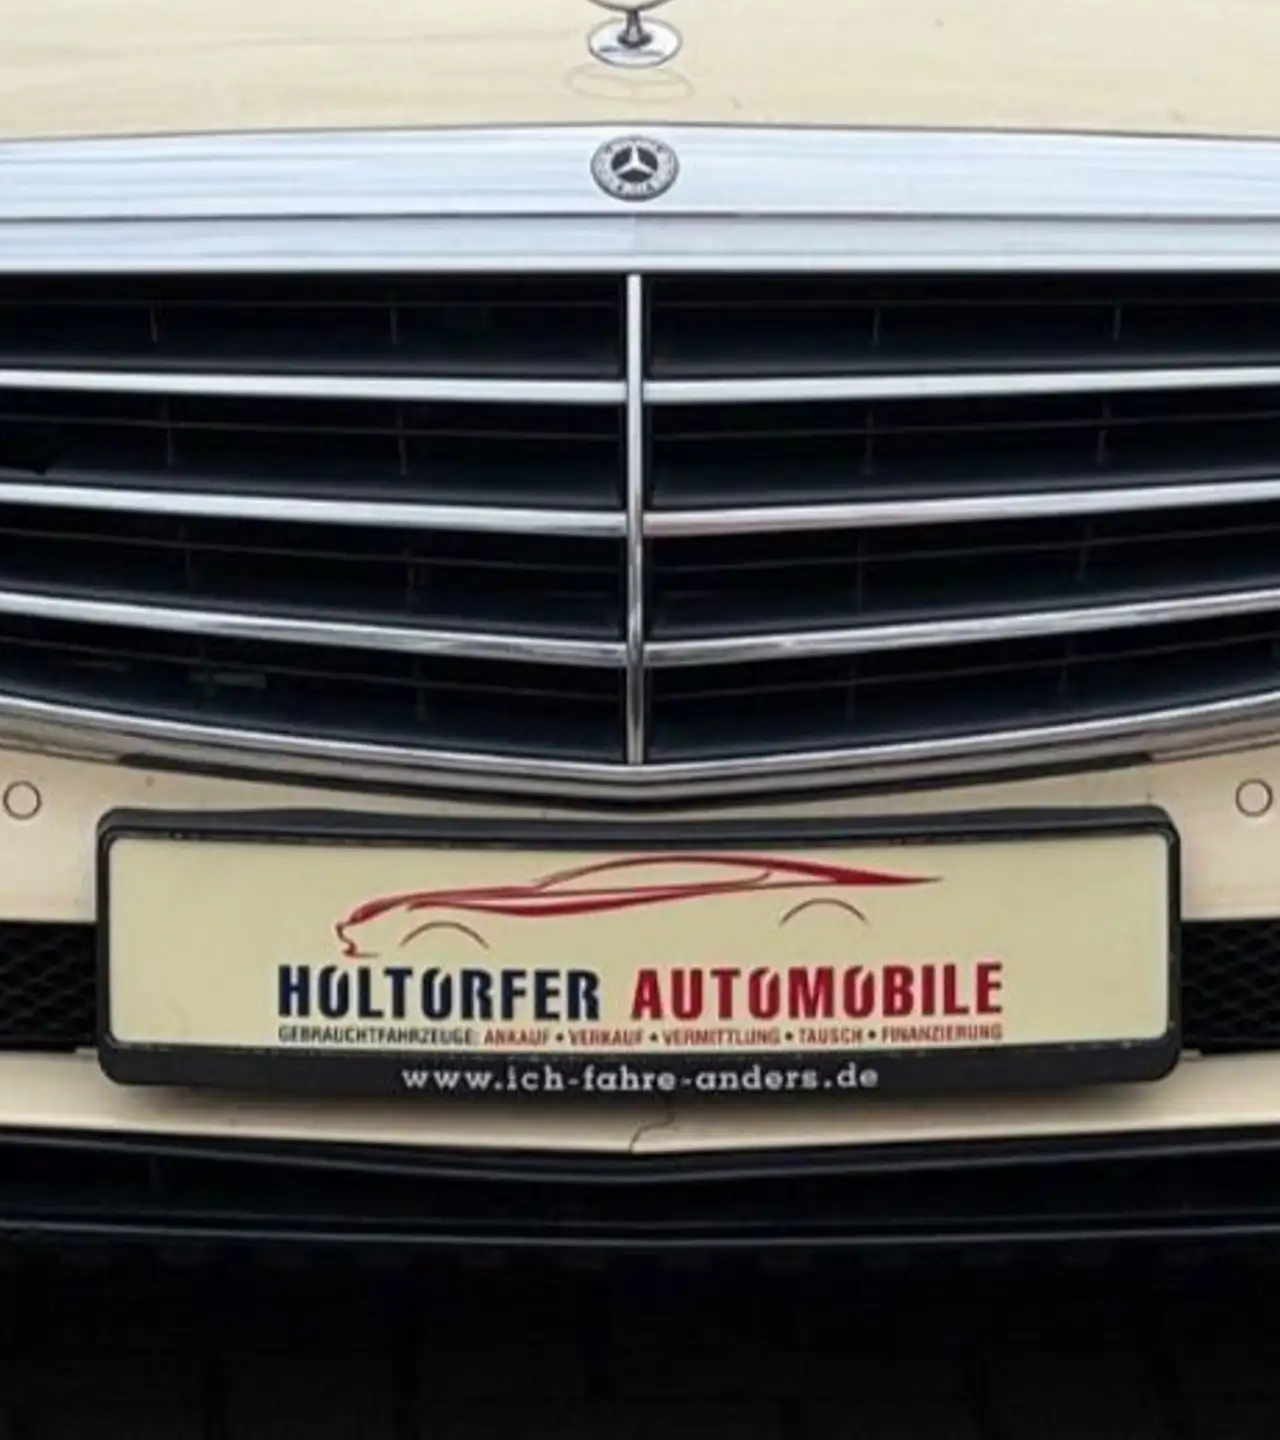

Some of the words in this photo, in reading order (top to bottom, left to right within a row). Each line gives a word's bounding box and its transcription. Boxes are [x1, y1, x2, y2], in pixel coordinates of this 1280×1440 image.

[630, 962, 1004, 1021] AUTOMOBILE
[483, 1027, 550, 1047] ANKAUF
[568, 1027, 644, 1047] VERKAUF
[661, 1026, 782, 1047] VERMITTLUNG
[797, 1026, 864, 1046] TAUSCH
[880, 1023, 1004, 1045] FINANZIERUNG
[401, 1062, 880, 1093] www.ich-fahre-anders.de
